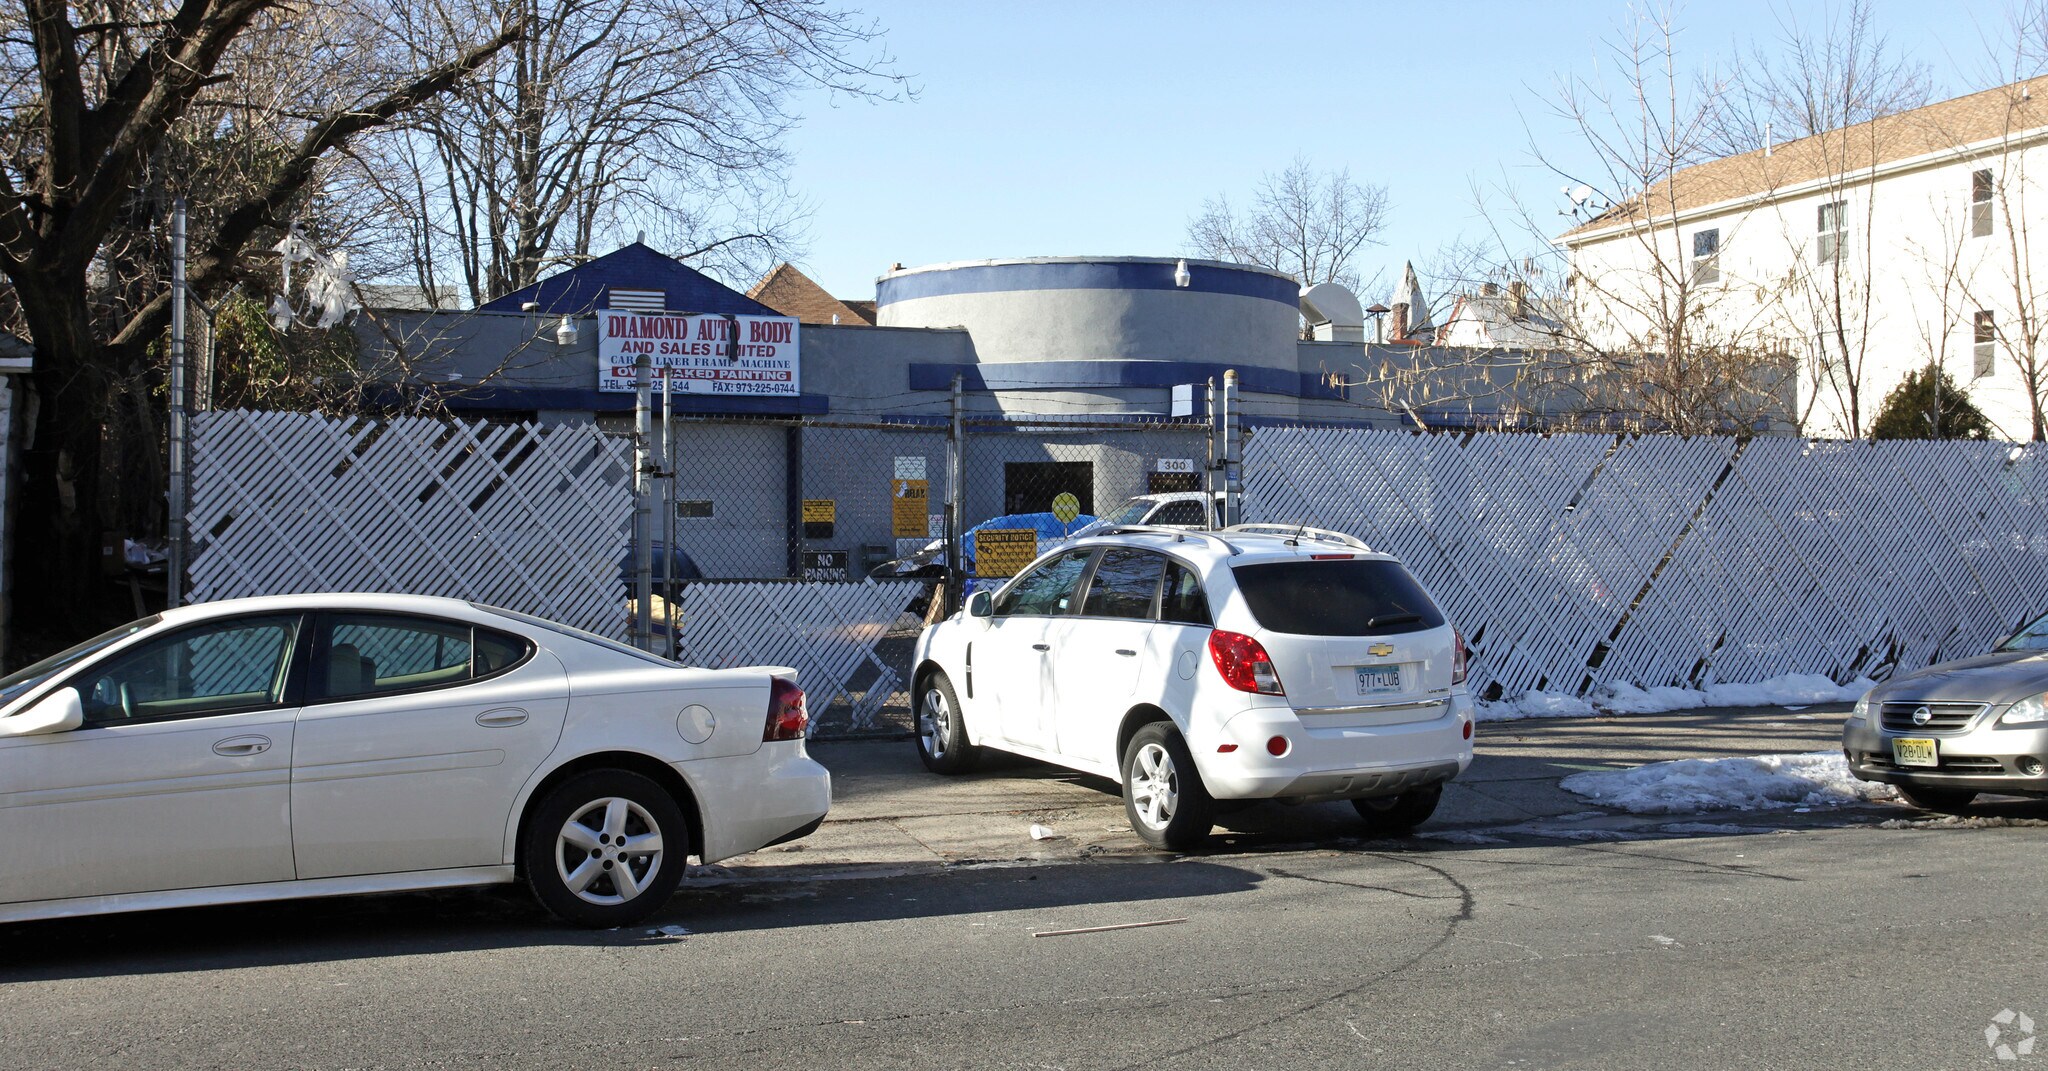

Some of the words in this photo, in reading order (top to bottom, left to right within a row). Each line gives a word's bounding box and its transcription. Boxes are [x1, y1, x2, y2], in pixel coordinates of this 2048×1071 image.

[608, 315, 688, 339] DIAMOND
[749, 321, 793, 343] BODY
[621, 340, 655, 353] AND
[660, 342, 711, 356] SALES
[611, 355, 634, 365] CAR
[656, 357, 689, 366] LINER
[694, 357, 734, 367] FRAME
[741, 360, 791, 369] MACHINE
[617, 367, 659, 378] OVN
[671, 368, 715, 379] AKED
[720, 370, 787, 381] PAINTING
[604, 379, 624, 390] TEL.
[713, 382, 733, 392] FAX:
[736, 383, 795, 393] 973-225-0744
[1164, 461, 1186, 471] 300
[817, 553, 834, 567] NO
[804, 568, 846, 581] PARKING
[1358, 673, 1376, 687] 977
[1381, 672, 1400, 686] LUB
